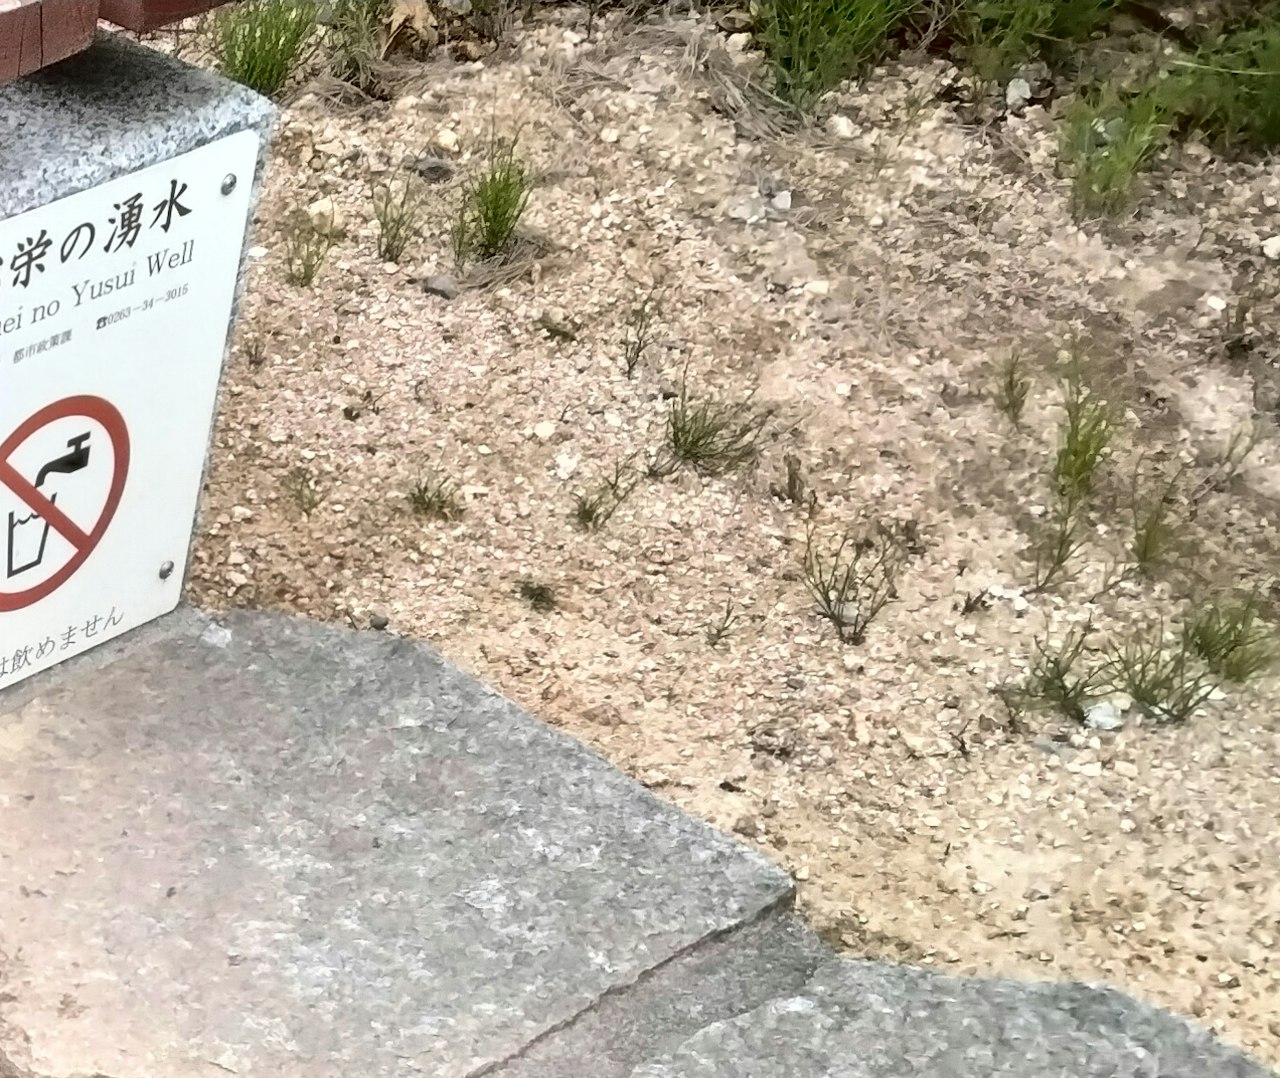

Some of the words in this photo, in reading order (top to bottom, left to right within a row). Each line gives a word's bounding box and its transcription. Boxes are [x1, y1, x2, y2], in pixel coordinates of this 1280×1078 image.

[30, 298, 61, 326] no
[72, 262, 136, 308] Yusui
[146, 240, 195, 278] Well
